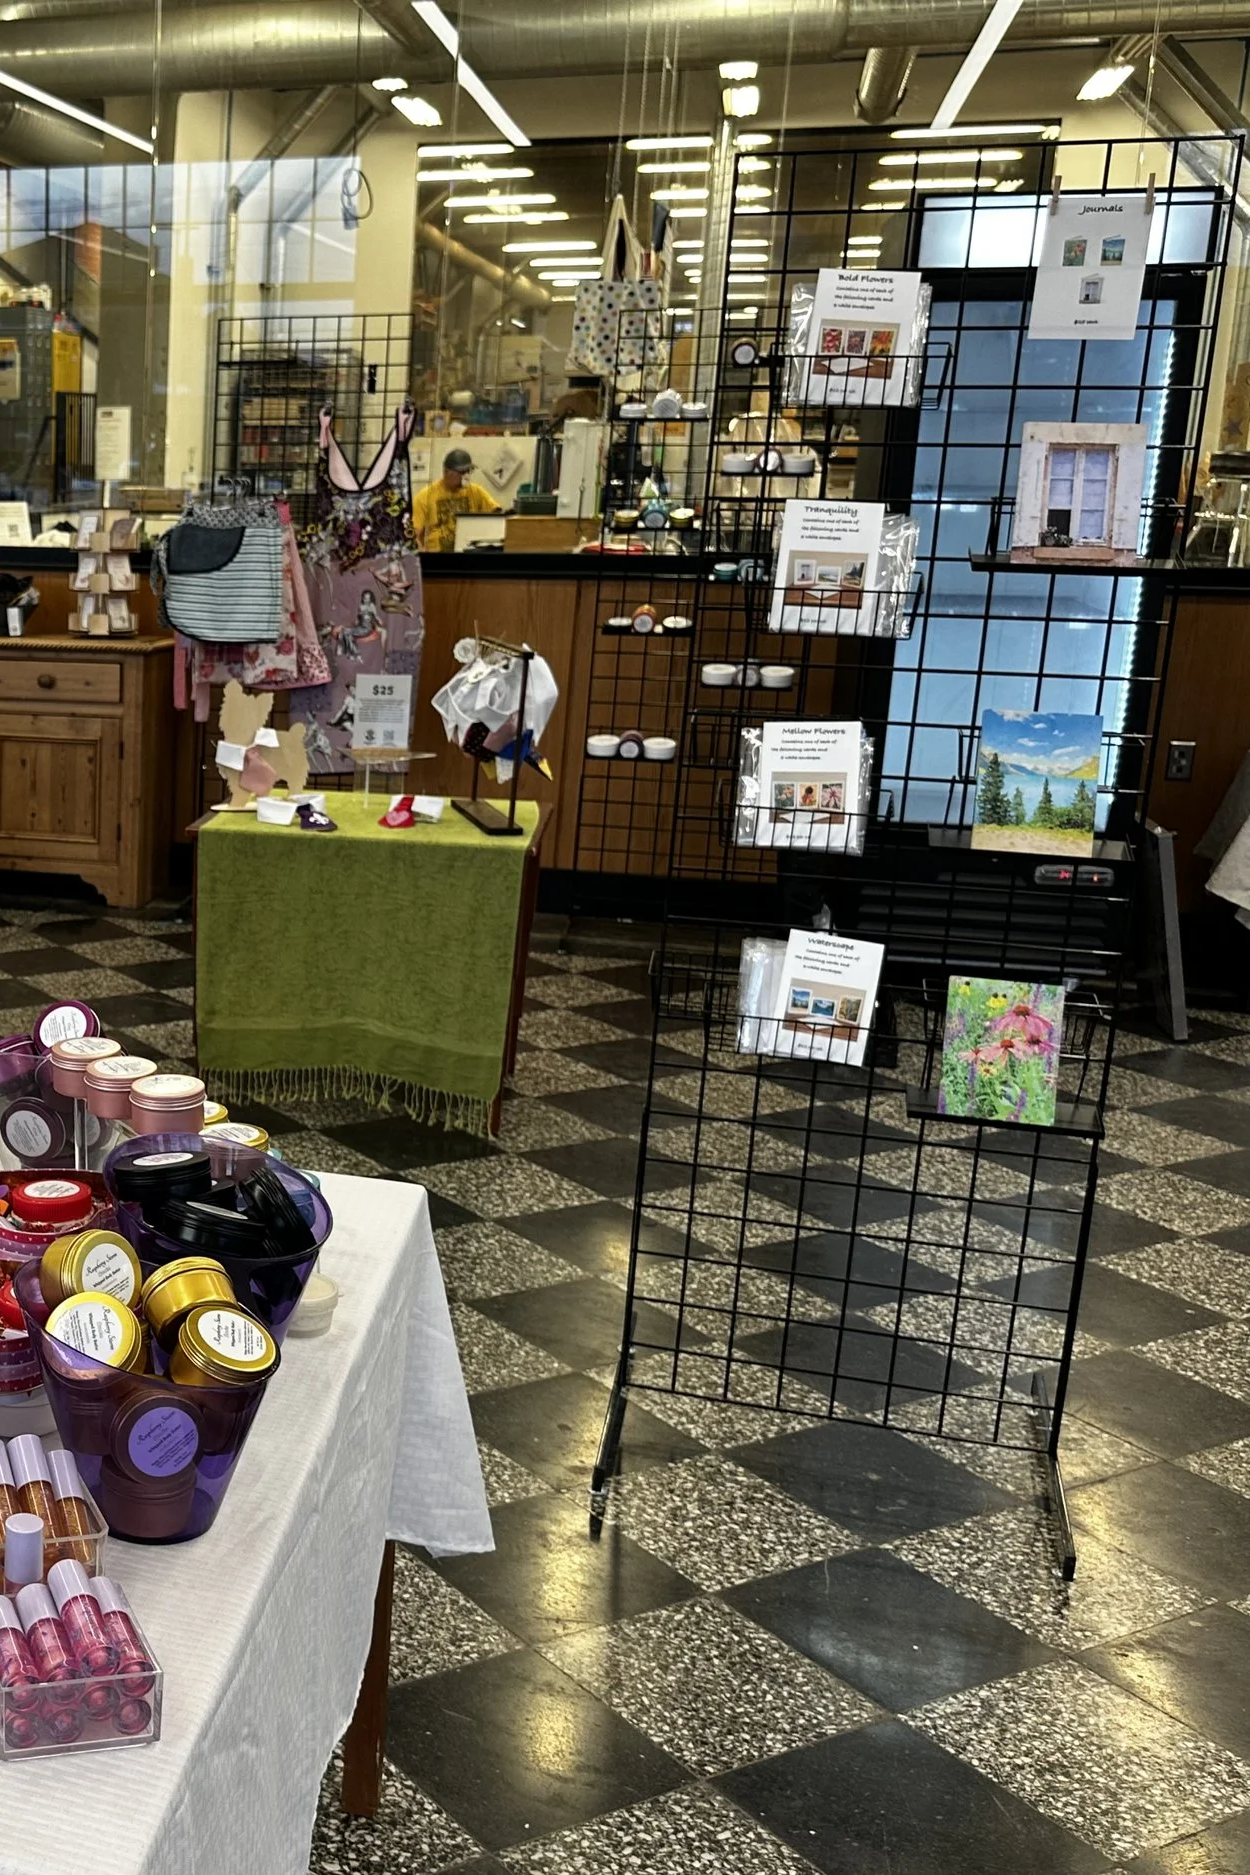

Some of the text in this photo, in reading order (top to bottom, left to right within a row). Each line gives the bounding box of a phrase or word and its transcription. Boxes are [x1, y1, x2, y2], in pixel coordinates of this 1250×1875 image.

[1078, 204, 1123, 216] Journals
[838, 274, 894, 284] Bold Flowers
[804, 505, 858, 518] Tranquility
[372, 684, 394, 696] $25
[782, 727, 812, 735] Mellow
[808, 938, 854, 952] Waterscape
